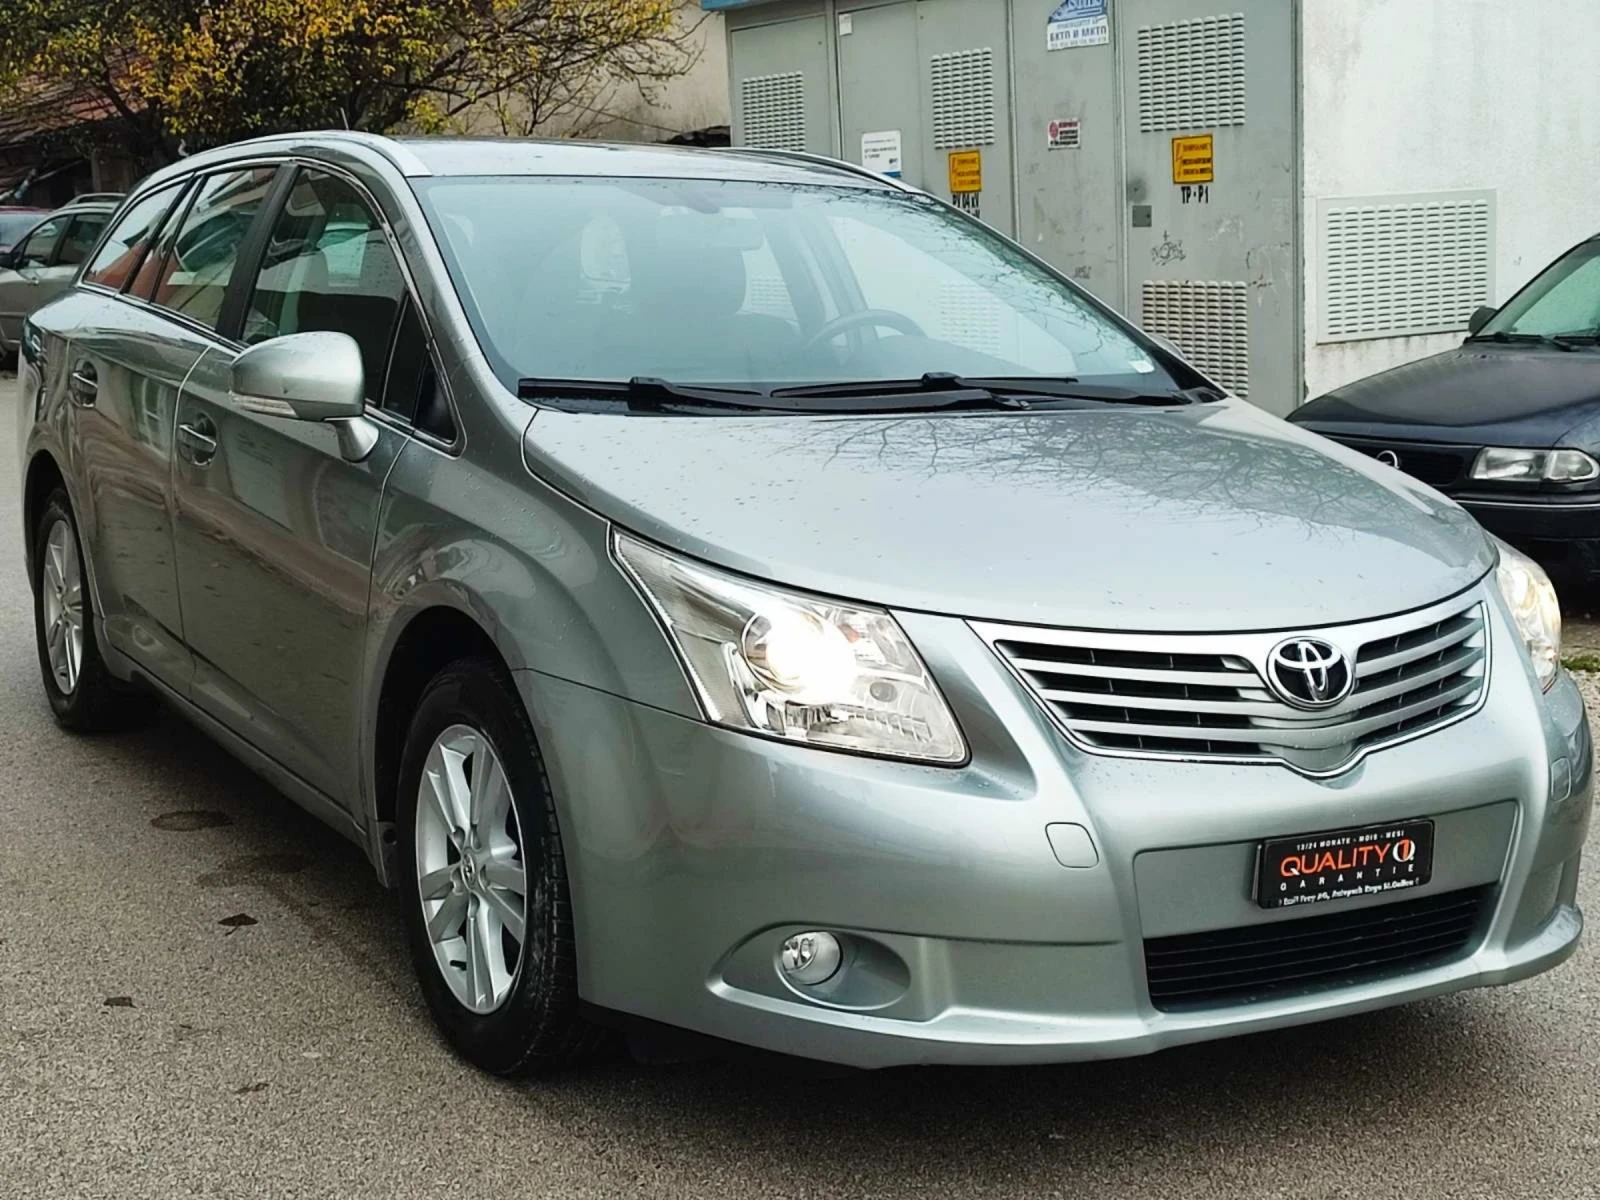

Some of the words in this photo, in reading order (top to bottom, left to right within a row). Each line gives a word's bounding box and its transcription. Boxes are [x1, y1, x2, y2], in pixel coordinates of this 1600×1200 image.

[1319, 837, 1351, 848] MONATE
[1358, 833, 1378, 842] MOIS
[1280, 842, 1391, 877] QUALITY
